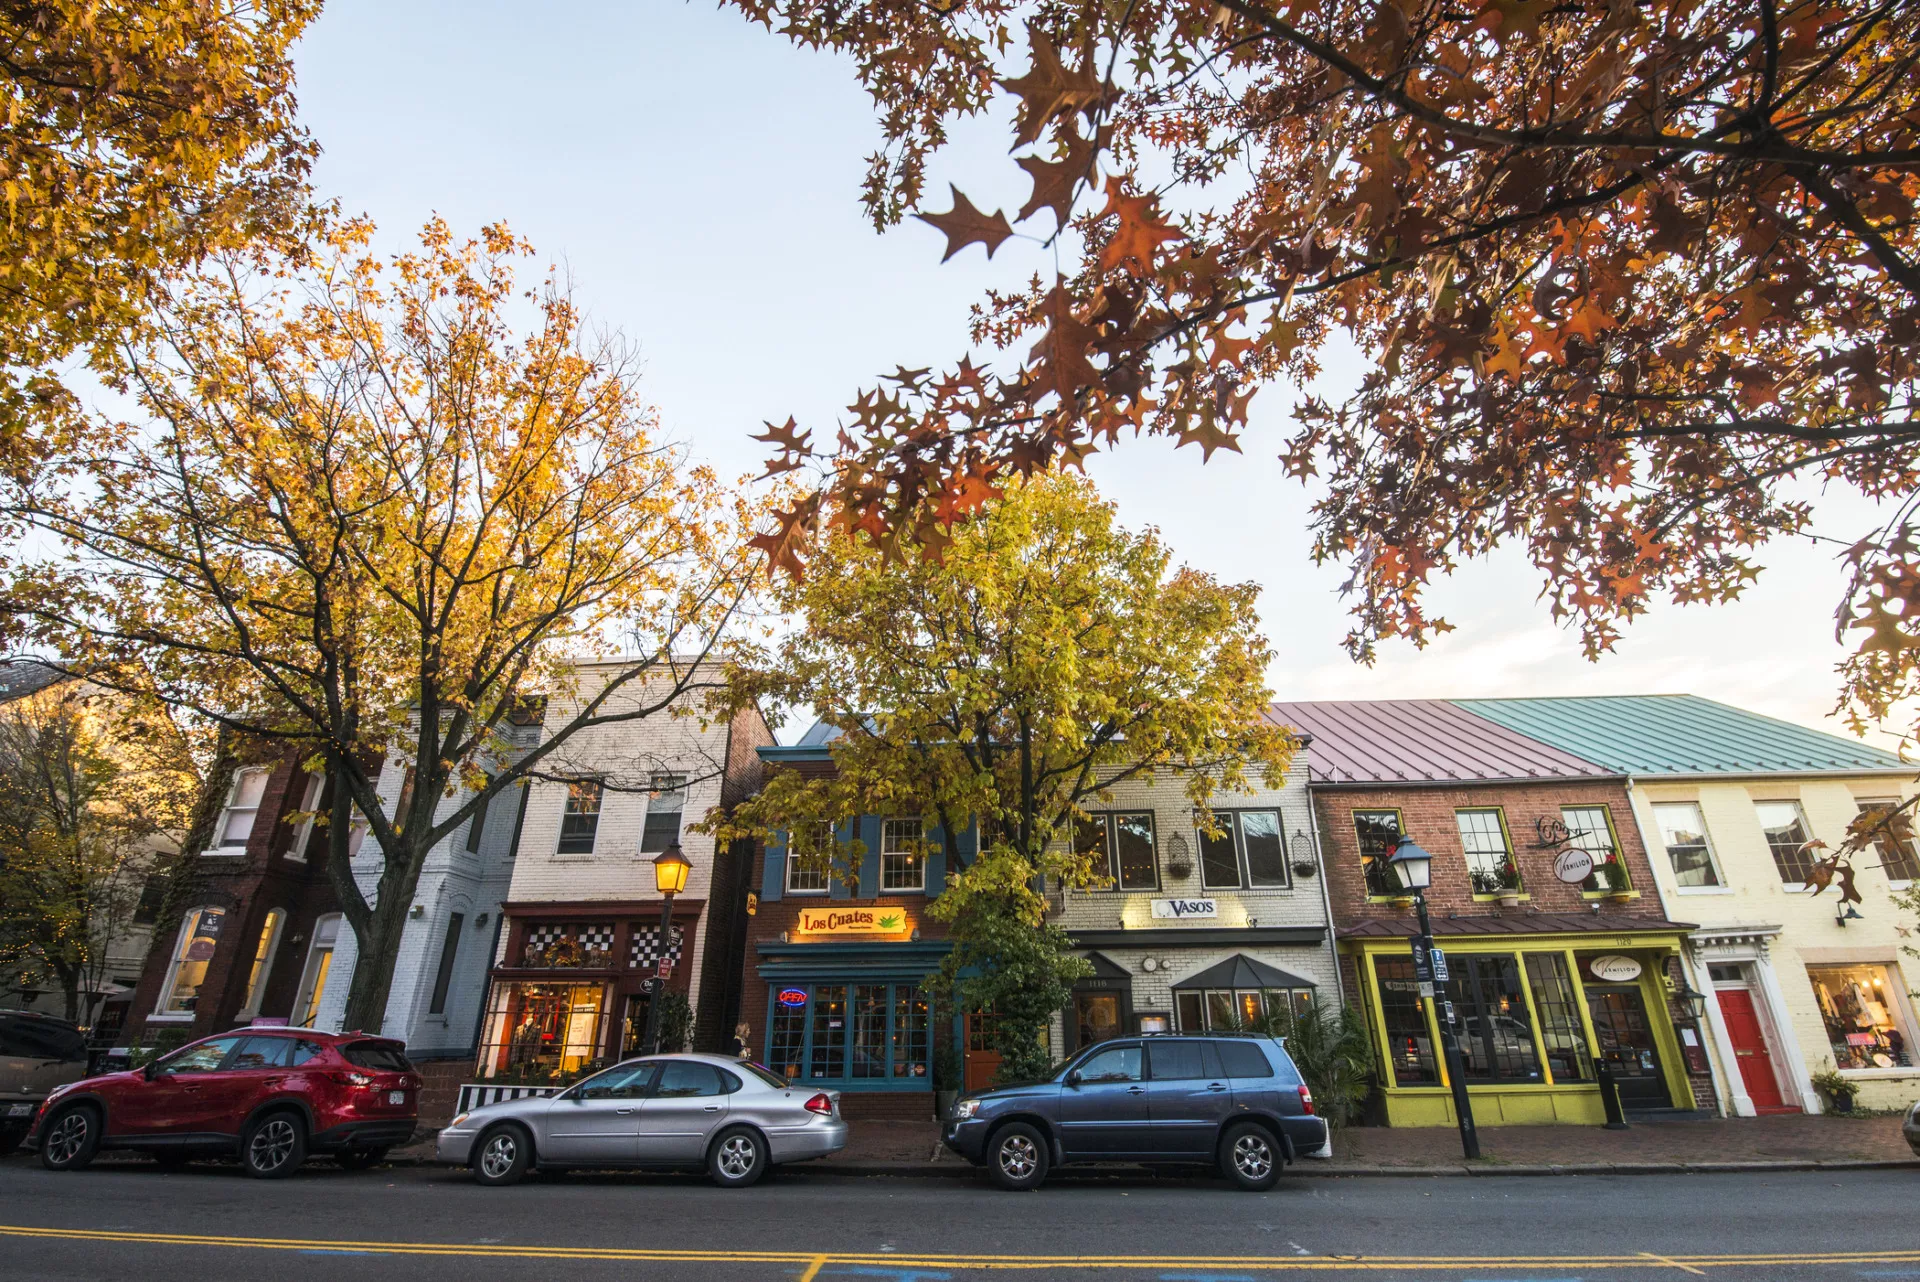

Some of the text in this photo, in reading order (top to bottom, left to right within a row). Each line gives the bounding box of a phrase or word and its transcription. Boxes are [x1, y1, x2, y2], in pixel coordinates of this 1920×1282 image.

[1168, 900, 1214, 917] VASO'S
[804, 910, 874, 931] Los Cuates
[779, 991, 808, 1002] OPEN
